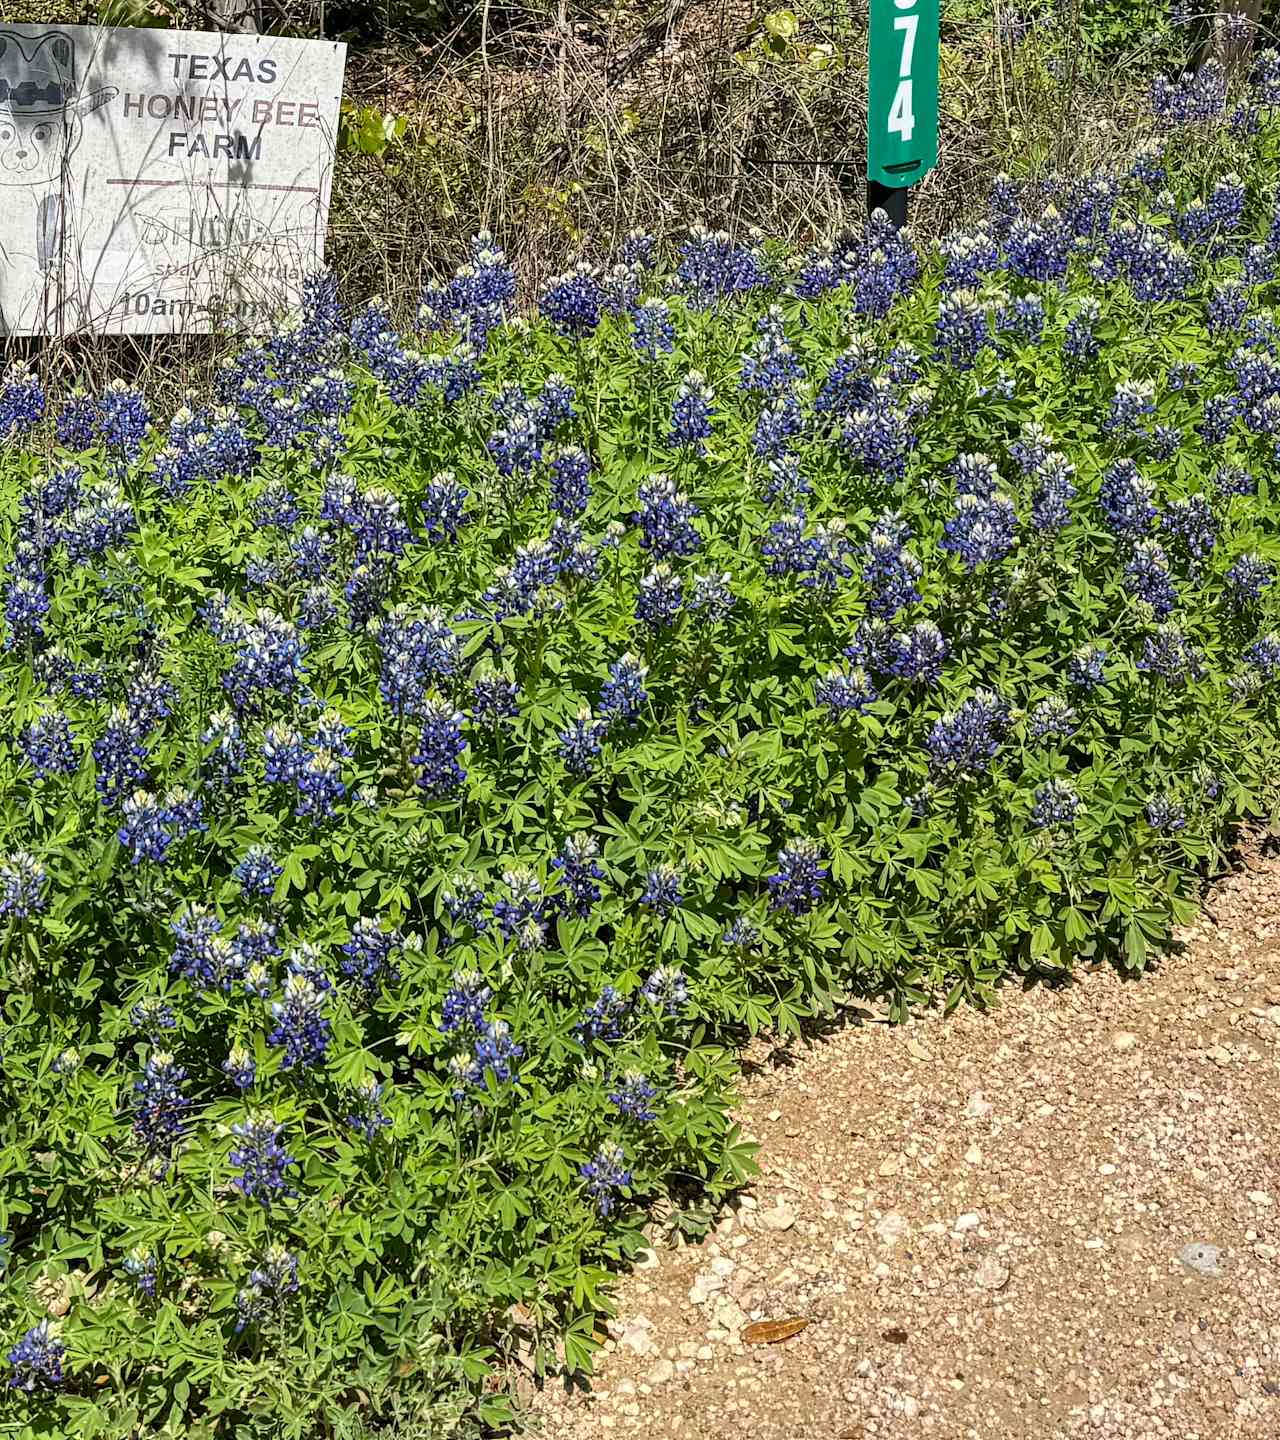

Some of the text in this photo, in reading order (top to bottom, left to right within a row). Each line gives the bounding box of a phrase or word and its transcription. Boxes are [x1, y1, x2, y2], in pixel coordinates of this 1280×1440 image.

[167, 53, 278, 85] TEXAS
[123, 92, 319, 128] HONEY BEE
[168, 131, 263, 162] FARM
